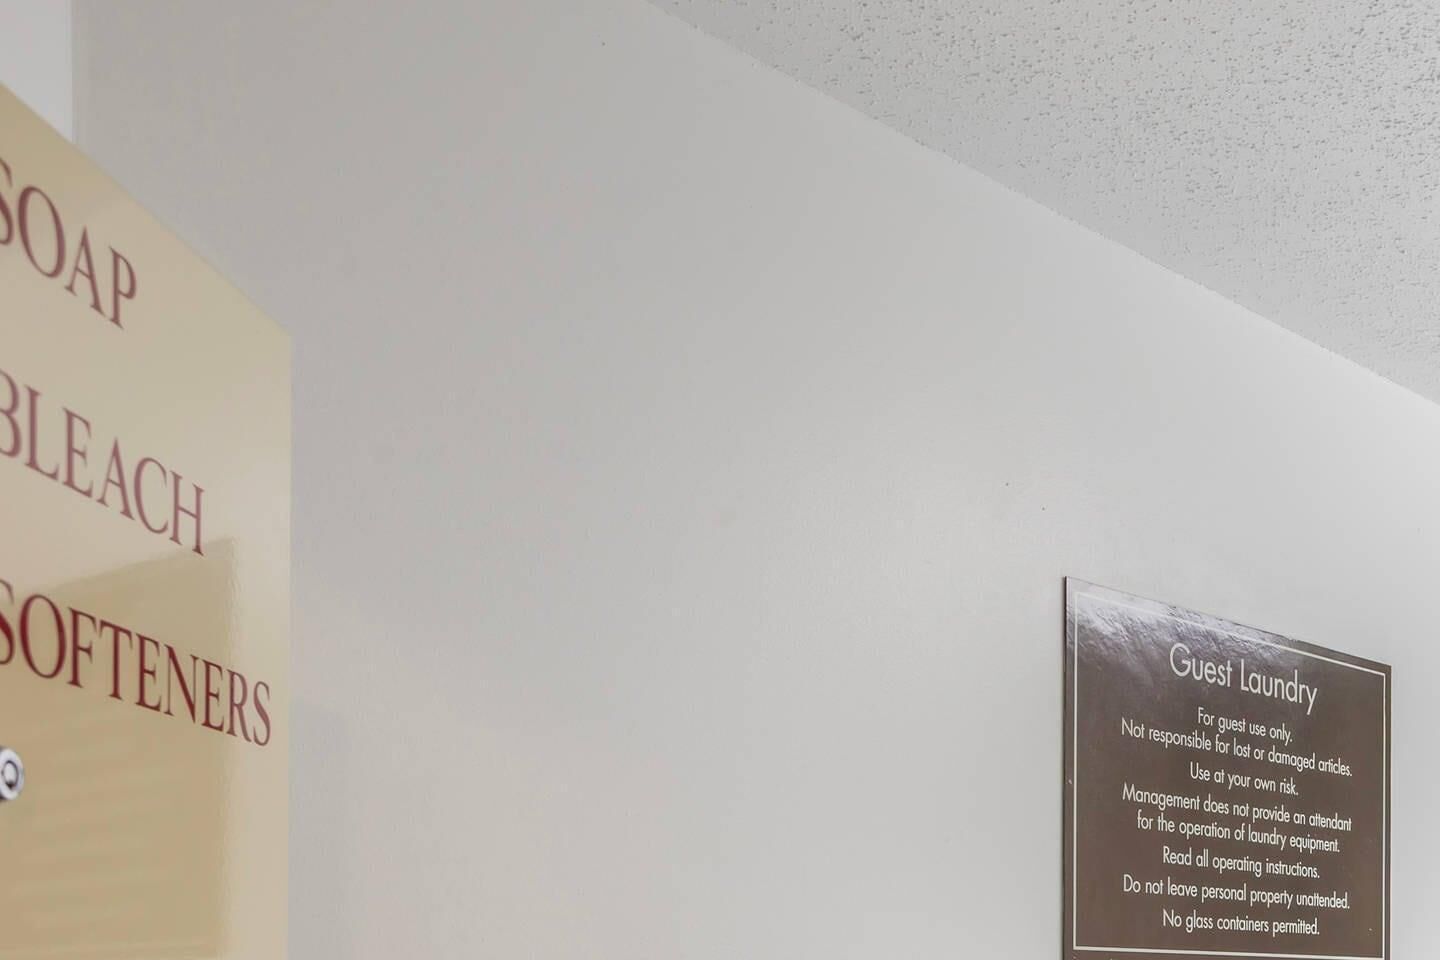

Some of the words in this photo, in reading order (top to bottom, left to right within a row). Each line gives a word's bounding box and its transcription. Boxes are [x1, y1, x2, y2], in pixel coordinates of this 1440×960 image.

[1169, 642, 1232, 687] Guest
[1240, 659, 1317, 715] Laundry
[1198, 707, 1215, 727] For
[1218, 716, 1246, 733] guest
[1249, 722, 1266, 737] use
[1270, 723, 1293, 745] only.
[1121, 717, 1145, 739] Not
[1148, 726, 1212, 751] responsible
[1215, 734, 1230, 754] for
[1233, 738, 1251, 757] lost
[1254, 747, 1265, 760] or
[1268, 745, 1315, 772] damaged
[1318, 755, 1353, 777] articles.
[1190, 761, 1210, 781] Use
[1214, 767, 1225, 784] at
[1228, 773, 1251, 790] your
[1254, 778, 1276, 792] own
[1279, 777, 1299, 796] risk.
[1122, 783, 1200, 812] Management
[1203, 794, 1230, 815] does
[1233, 801, 1250, 817] not
[1252, 803, 1290, 825] provide
[1293, 812, 1306, 825] an
[1308, 812, 1352, 832] attendant
[1137, 810, 1152, 830] for
[1157, 814, 1175, 833] the
[1179, 818, 1231, 840] operation
[1234, 822, 1246, 841] of
[1248, 824, 1287, 850] laundry
[1290, 834, 1340, 853] equipment.
[1163, 846, 1192, 868] Read
[1195, 850, 1209, 869] all
[1212, 855, 1262, 877] operating
[1266, 859, 1320, 879] instructions.
[1123, 874, 1141, 893] Do
[1145, 879, 1163, 895] not
[1167, 877, 1198, 898] leave
[1201, 884, 1246, 904] personal
[1250, 890, 1293, 910] property
[1296, 891, 1351, 910] unattended.
[1163, 909, 1182, 928] No
[1186, 911, 1214, 934] glass
[1217, 914, 1269, 933] containers
[1272, 917, 1320, 937] permitted.
